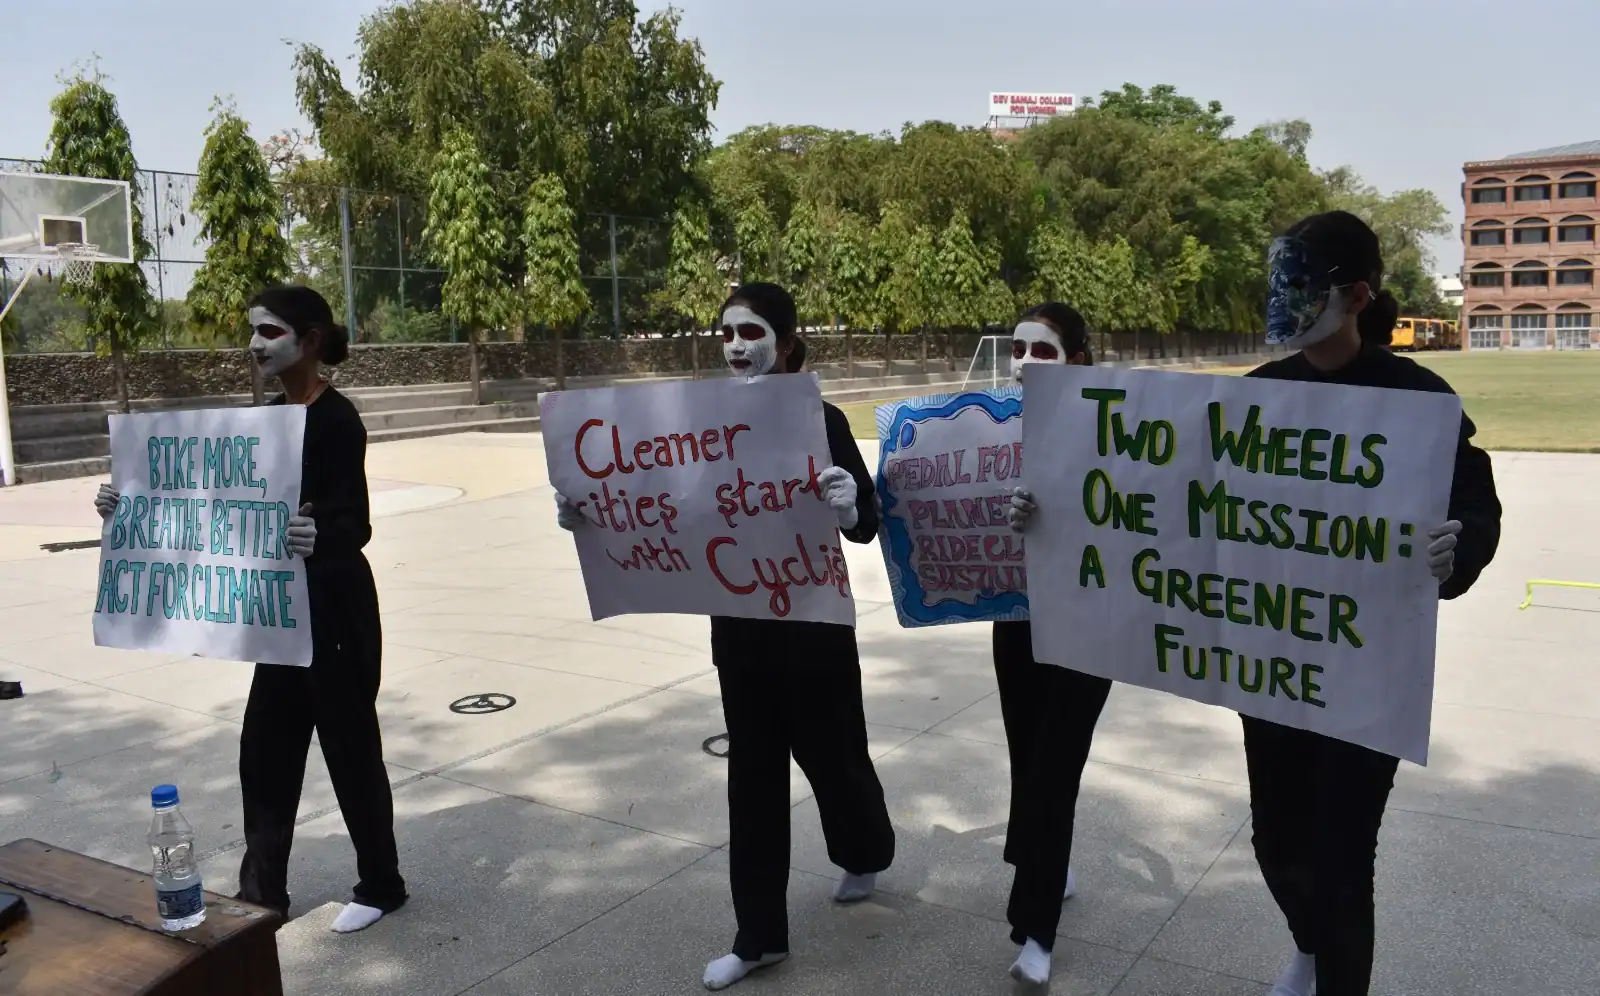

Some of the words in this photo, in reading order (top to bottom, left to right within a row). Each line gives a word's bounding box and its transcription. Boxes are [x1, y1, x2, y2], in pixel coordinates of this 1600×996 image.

[993, 95, 1008, 104] DEV
[1010, 95, 1037, 105] SAMAJ
[1040, 96, 1073, 105] COLLEGE
[1010, 105, 1025, 114] FOR
[1027, 105, 1057, 114] WOMEN
[148, 436, 198, 490] BIKE
[203, 435, 268, 498] MORE,
[574, 418, 751, 479] Cleaner
[887, 448, 972, 491] PEDAL
[716, 455, 825, 528] start
[111, 495, 206, 551] BREATHE
[210, 498, 295, 560] BETTER
[916, 534, 982, 563] RIDE
[606, 537, 691, 573] with
[1079, 544, 1106, 589] A
[95, 559, 146, 614] ACT
[147, 562, 190, 620] FOR
[192, 563, 297, 628] CLIMATE
